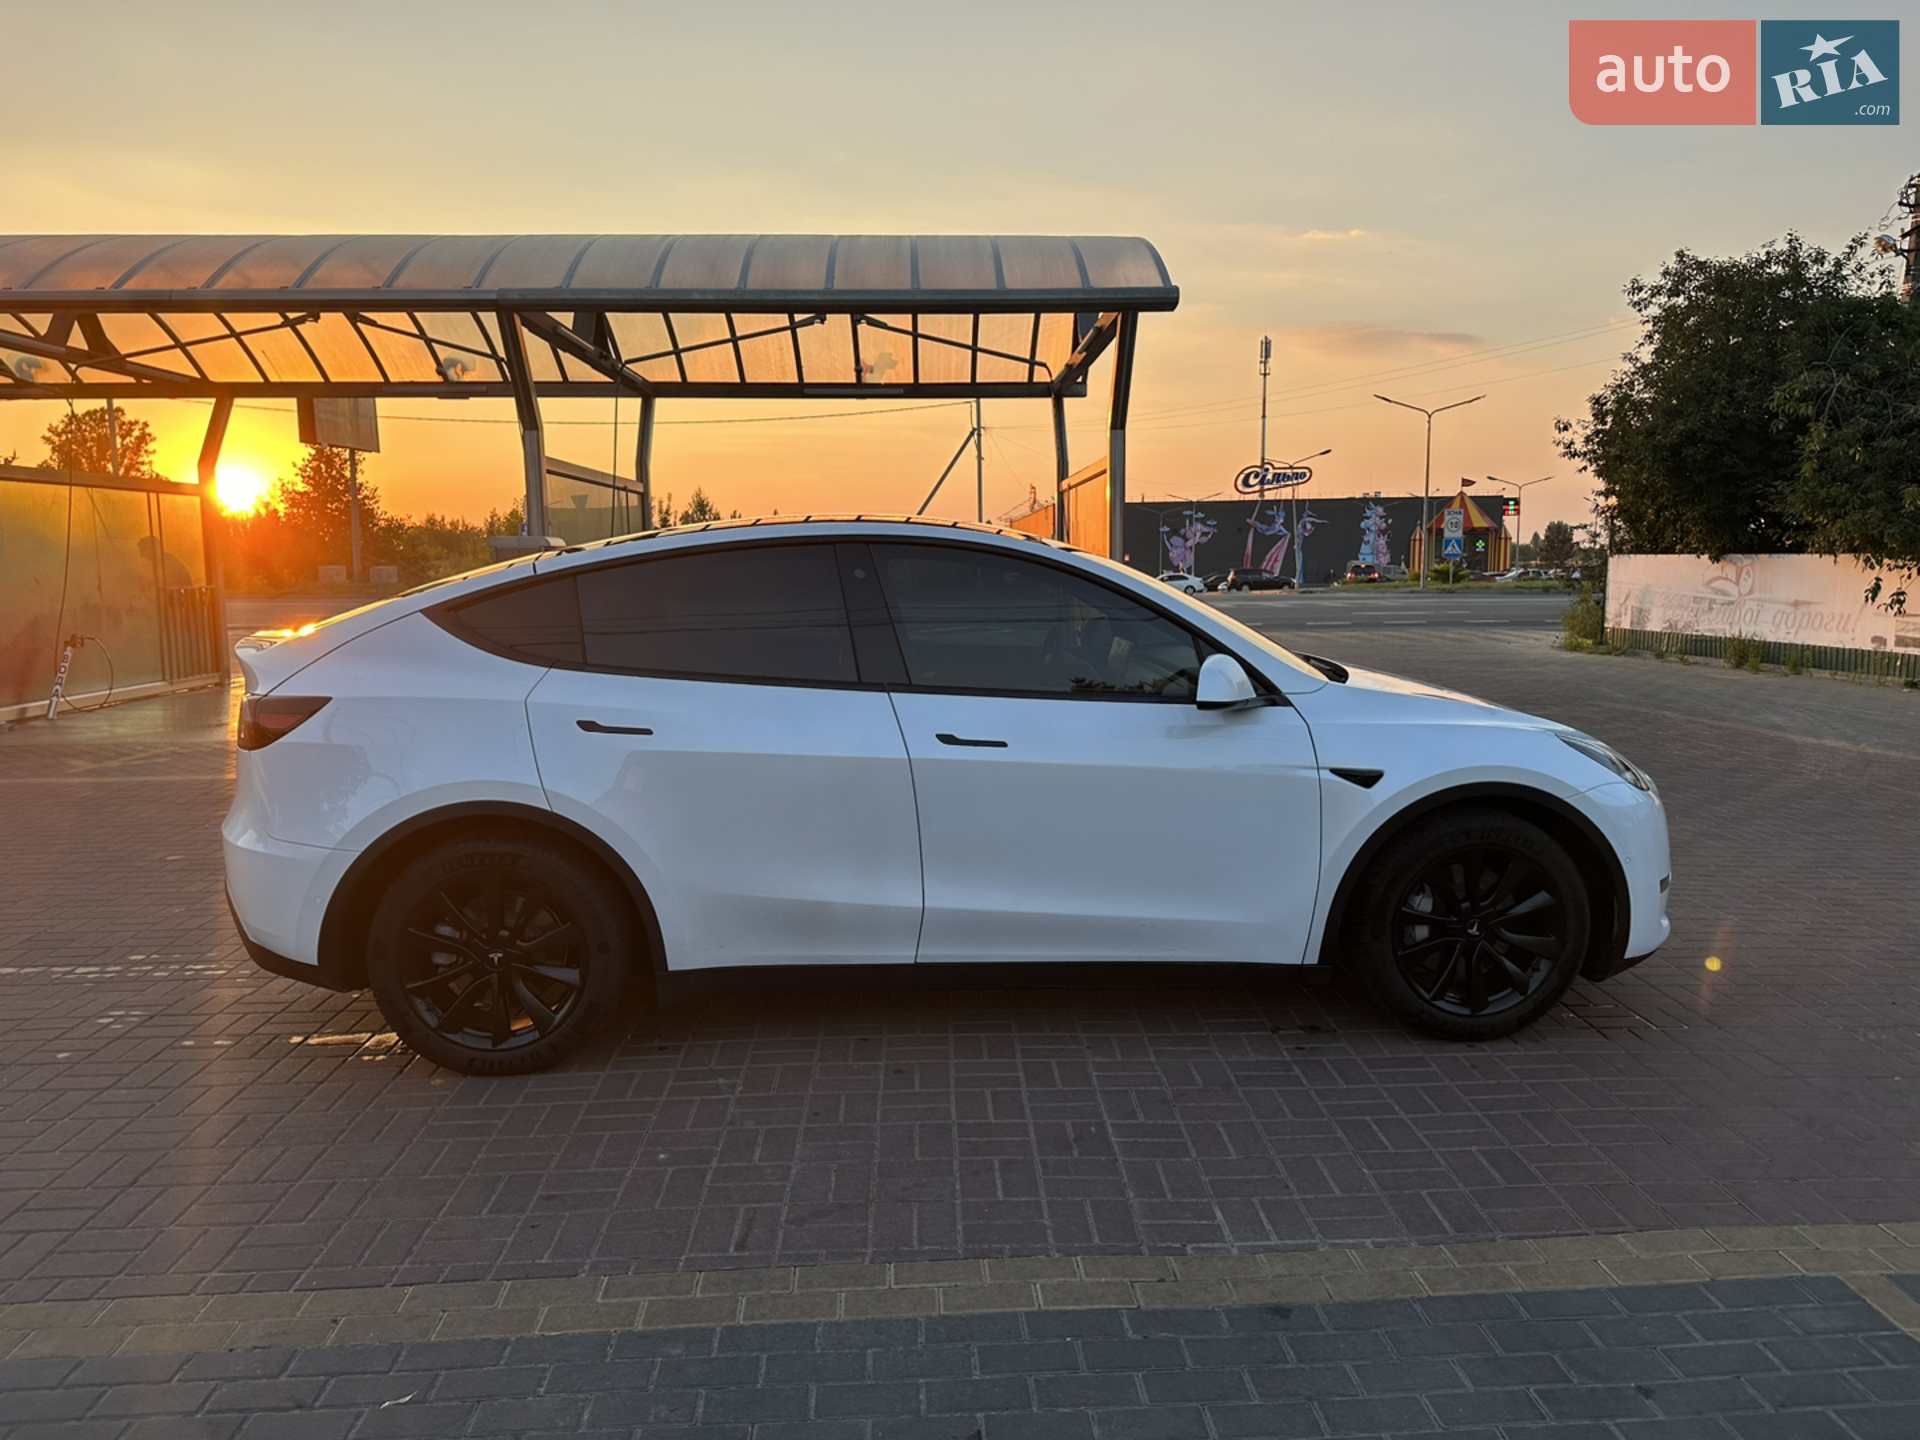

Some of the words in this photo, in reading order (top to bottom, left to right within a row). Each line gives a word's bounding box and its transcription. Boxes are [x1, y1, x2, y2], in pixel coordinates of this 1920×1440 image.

[1242, 467, 1307, 488] Сільпо
[1449, 520, 1459, 529] 10
[1769, 603, 1864, 639] дороги!
[50, 653, 69, 699] ВОДА
